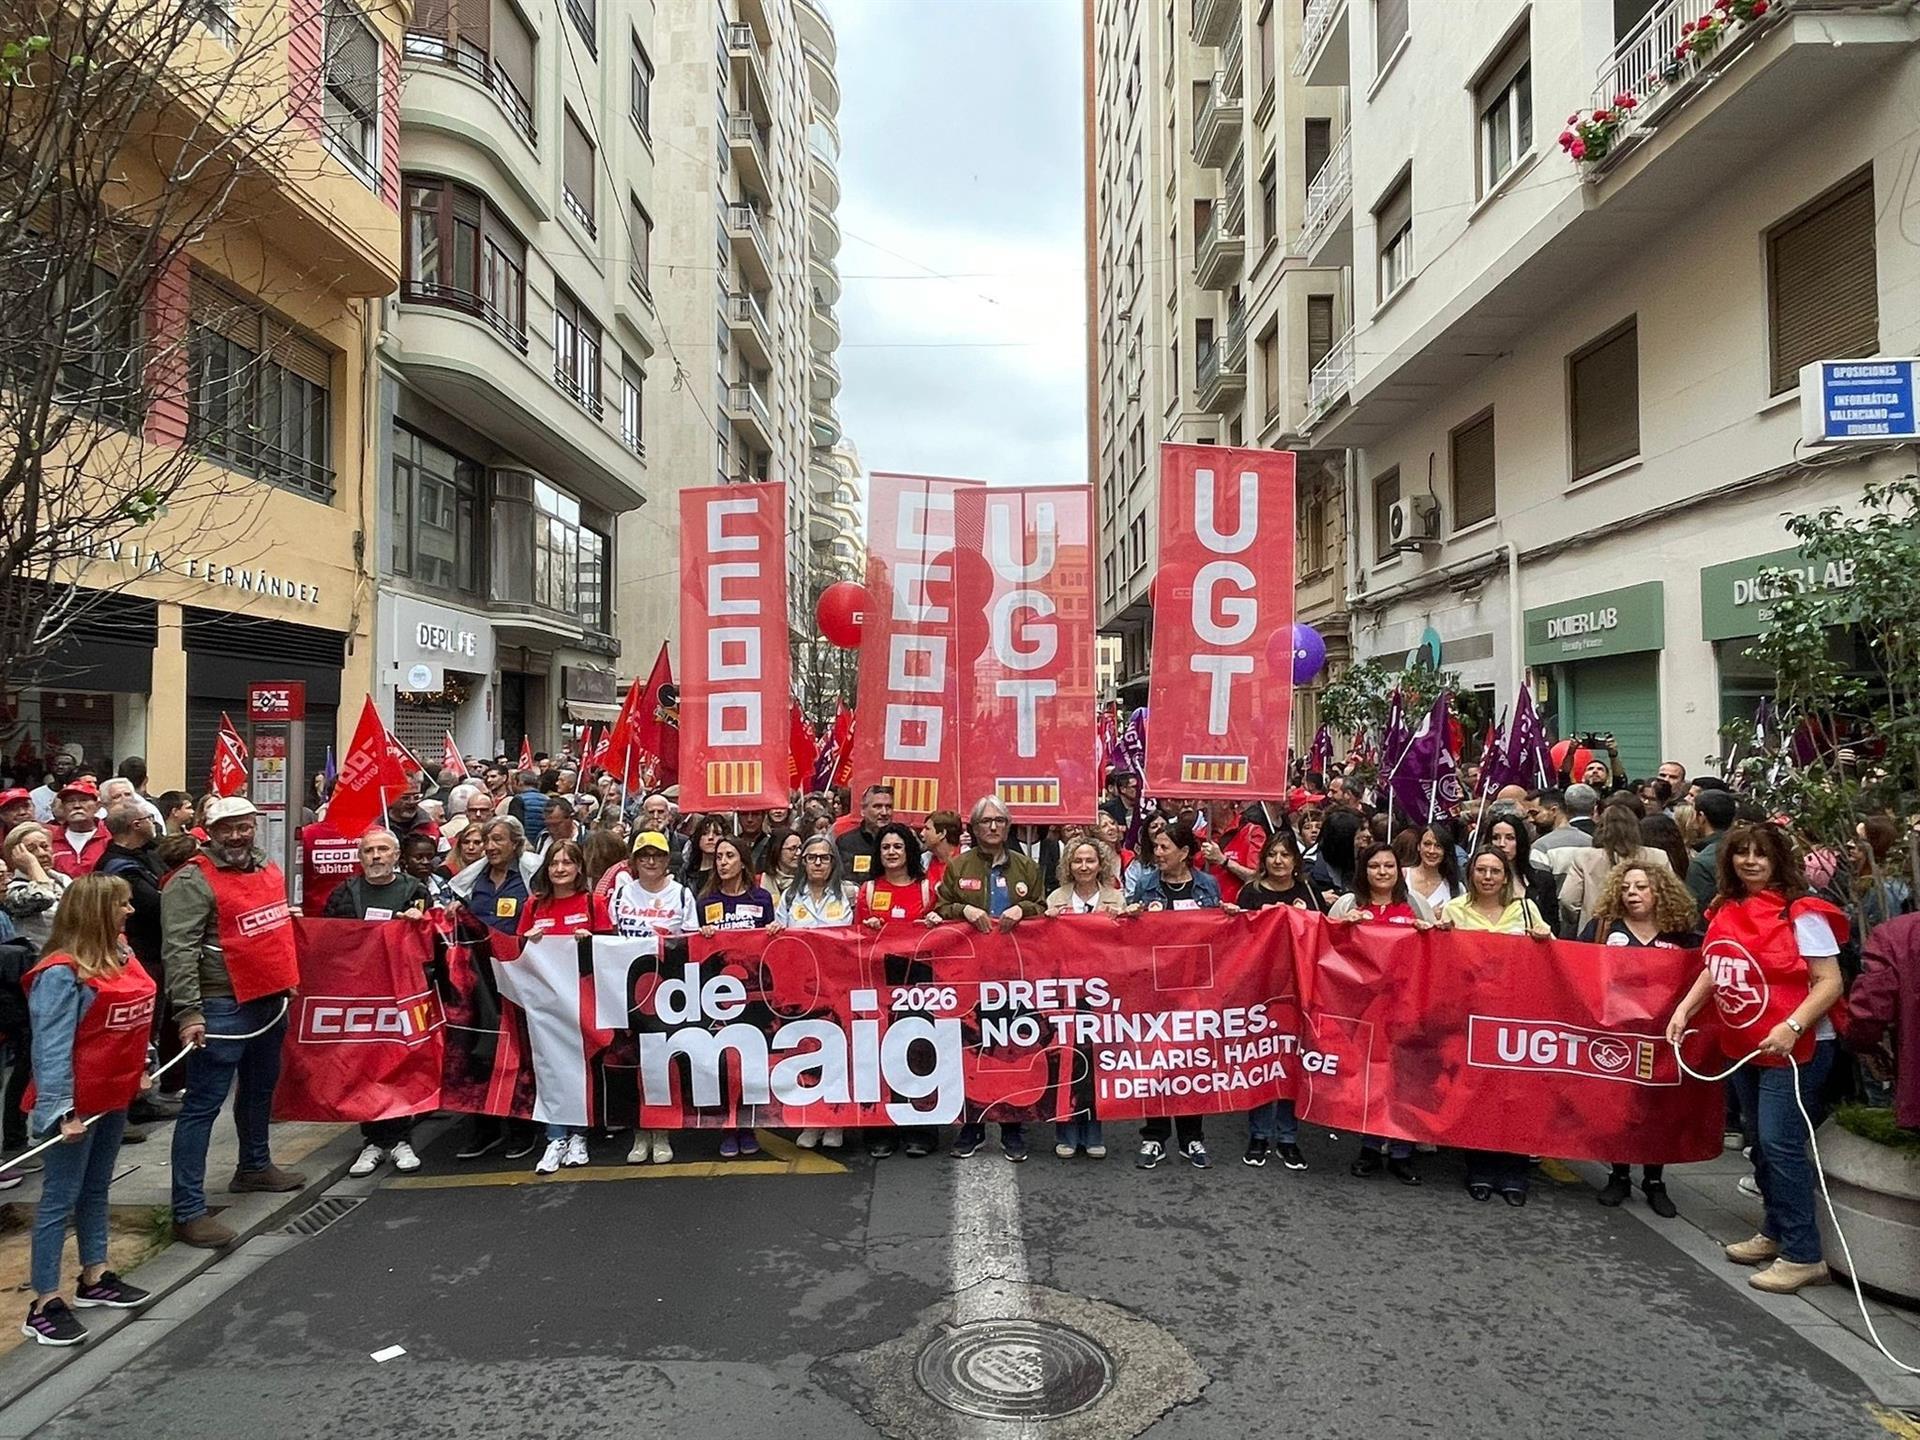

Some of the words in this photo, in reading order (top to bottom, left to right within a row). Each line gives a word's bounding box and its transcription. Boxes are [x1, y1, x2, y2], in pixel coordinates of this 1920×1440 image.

[189, 559, 320, 604] FERNÁNDEZ
[1190, 468, 1259, 736] UGT
[707, 497, 762, 747] CCOO
[883, 490, 957, 762] CCOO
[990, 502, 1059, 758] UGT
[654, 962, 747, 1025] de
[891, 987, 957, 1011] 2026
[980, 978, 1122, 1012] DRETS,
[980, 1018, 1040, 1047] NO
[1048, 1004, 1278, 1046] TRINXERES.
[1497, 1027, 1590, 1066] UGT
[639, 989, 965, 1126] maig
[1099, 1048, 1218, 1071] SALARIS,
[1224, 1034, 1339, 1076] HABITGE
[1101, 1078, 1107, 1100] I
[1114, 1060, 1287, 1099] DEMOCRÀCIA
